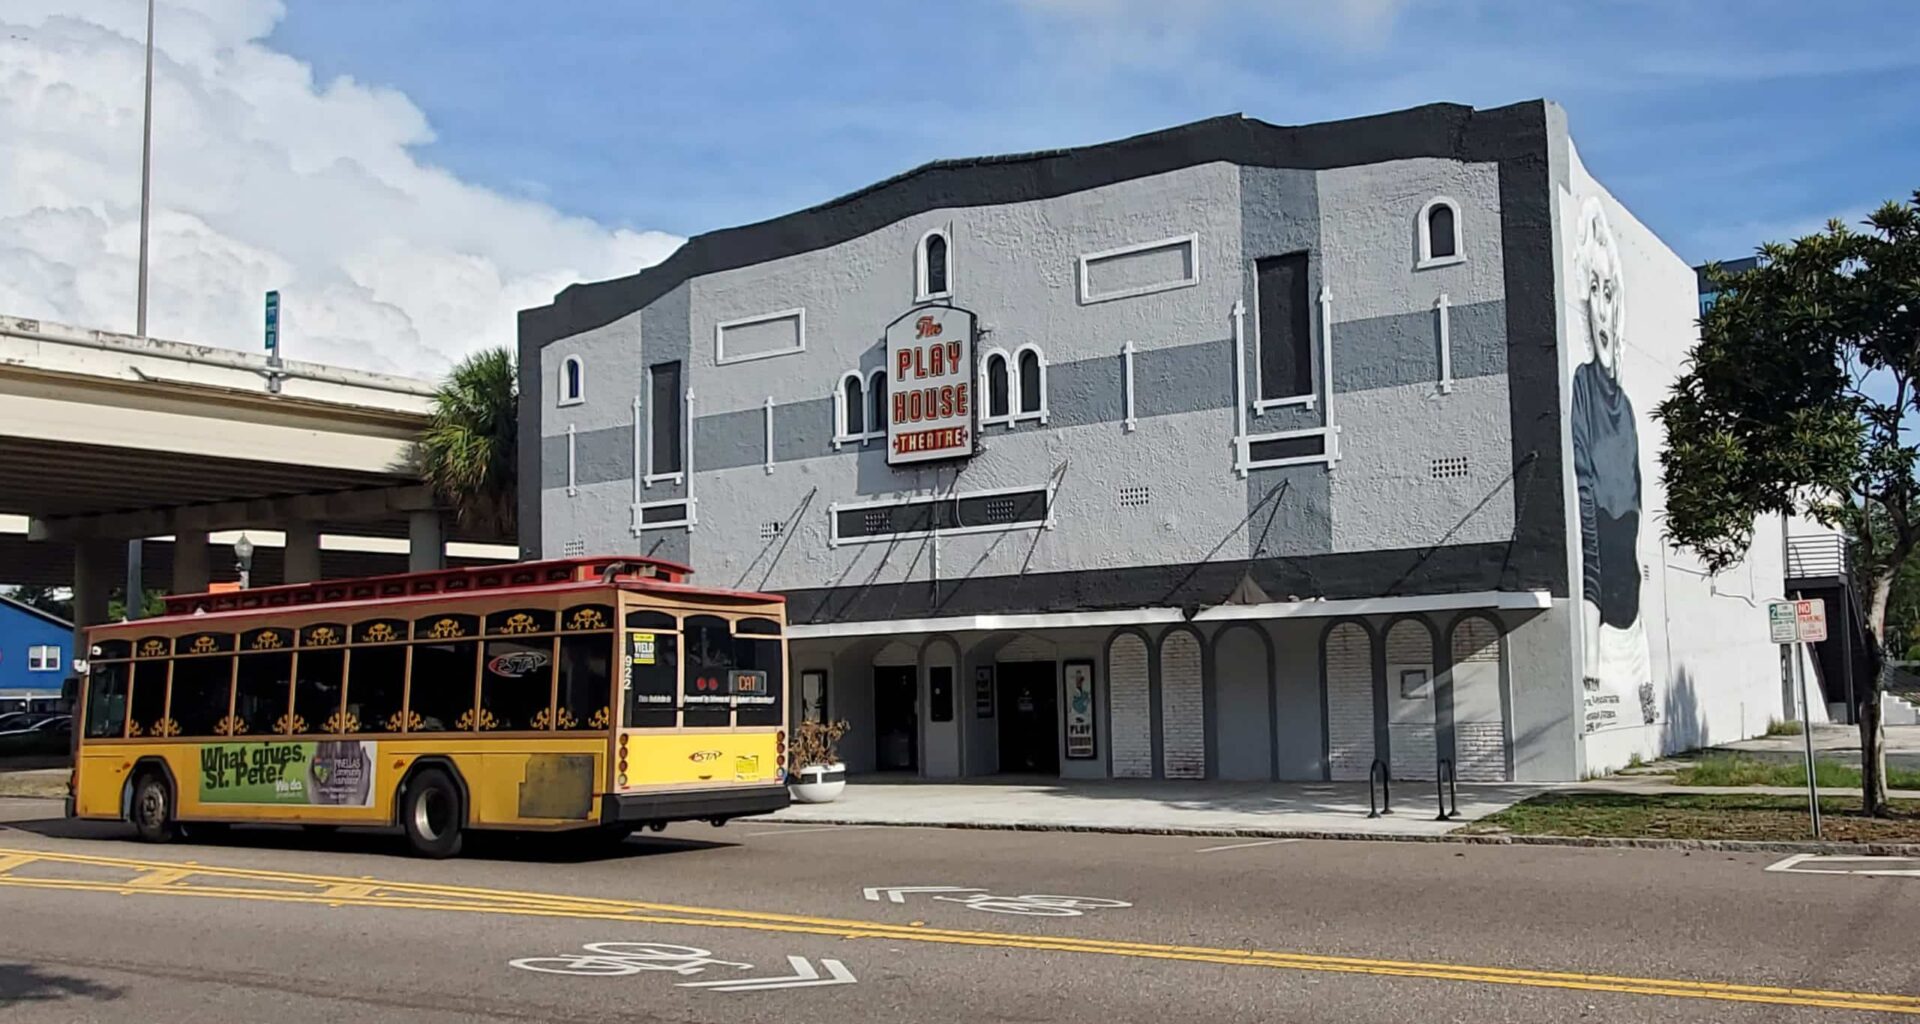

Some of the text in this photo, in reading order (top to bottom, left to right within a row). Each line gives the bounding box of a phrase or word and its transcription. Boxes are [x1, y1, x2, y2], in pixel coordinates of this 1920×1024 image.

[915, 316, 943, 339] The
[896, 341, 963, 382] PLAY
[892, 383, 968, 425] HOUSE
[899, 430, 962, 451] THEATRE
[1770, 606, 1776, 618] 2
[1798, 602, 1810, 614] NO
[634, 642, 654, 653] YIELD
[624, 655, 632, 690] 922
[201, 747, 246, 771] What
[205, 769, 230, 790] St.
